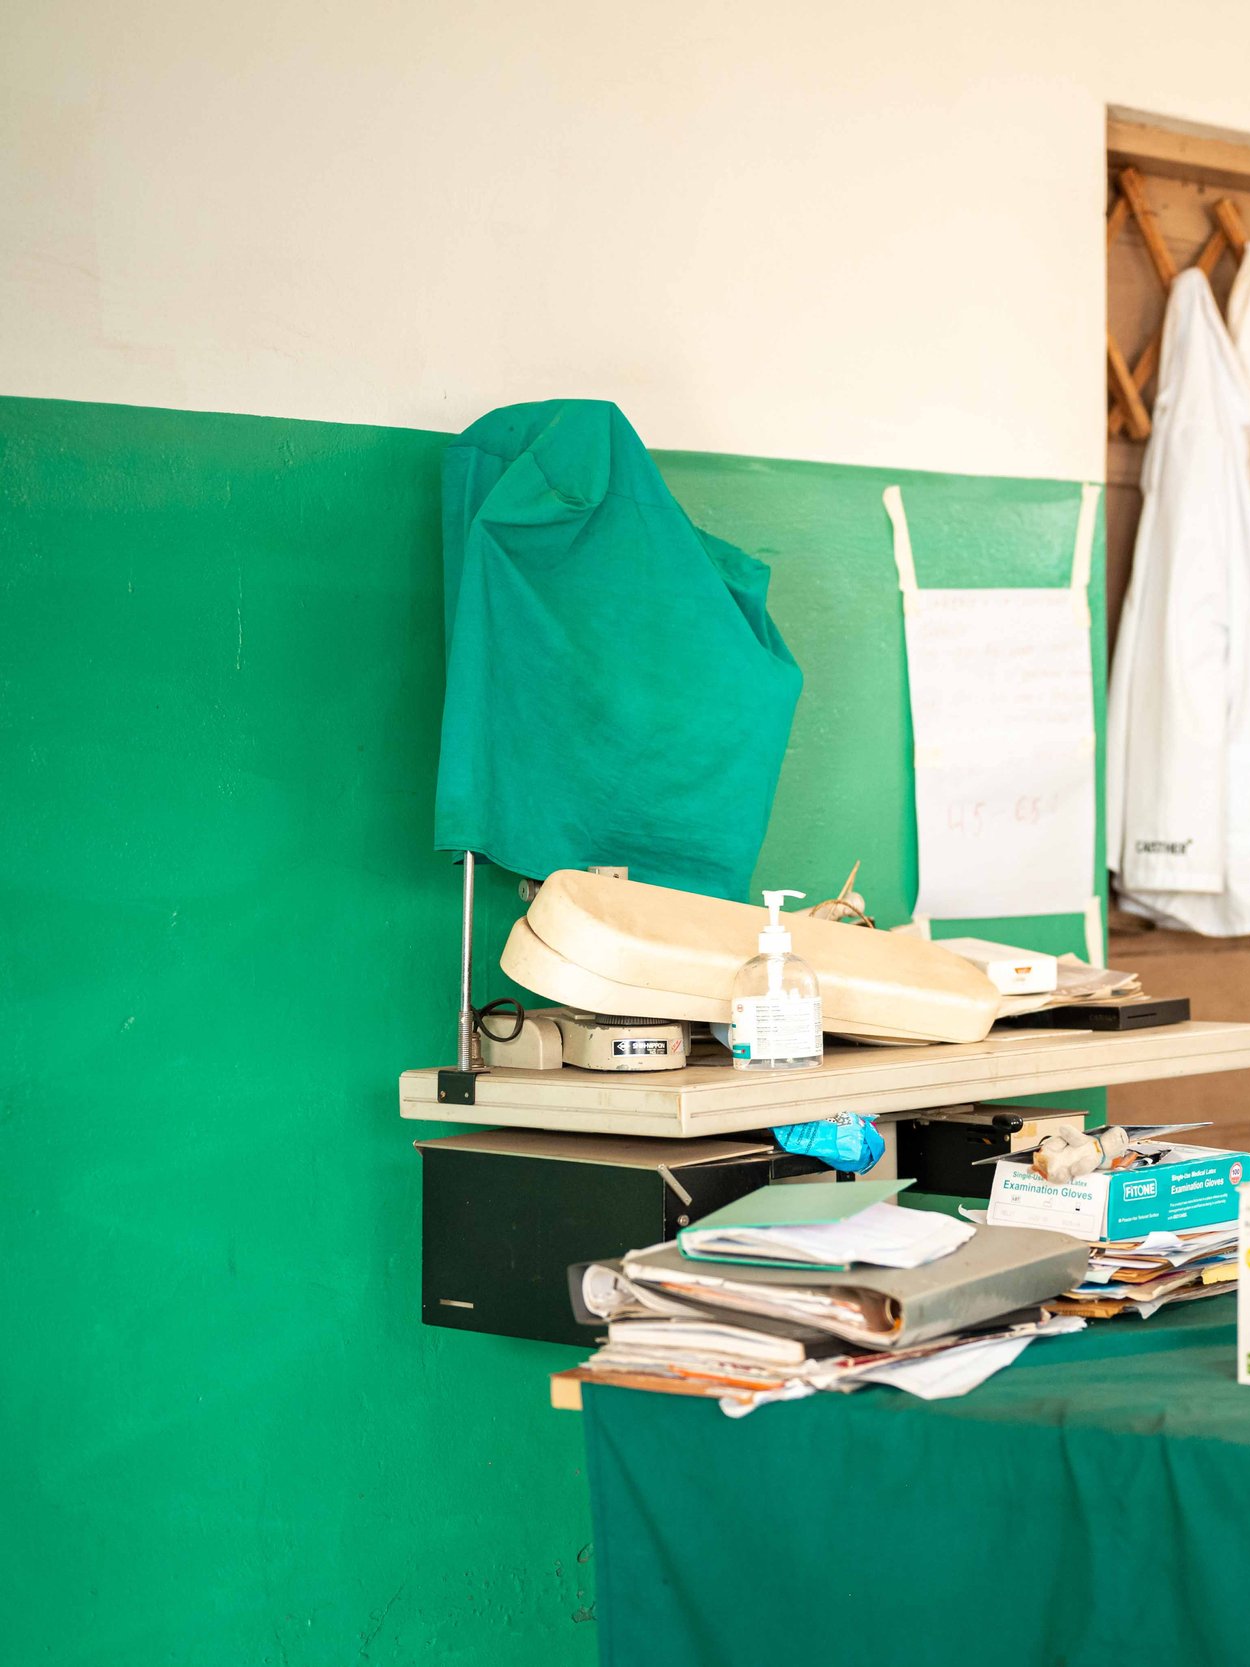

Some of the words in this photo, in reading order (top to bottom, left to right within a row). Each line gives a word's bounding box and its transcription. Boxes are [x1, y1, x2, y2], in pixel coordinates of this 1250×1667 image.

[1003, 1180, 1059, 1196] Examination
[1061, 1187, 1093, 1201] Gloves
[1171, 1181, 1203, 1194] Examination
[1205, 1178, 1224, 1187] Gloves
